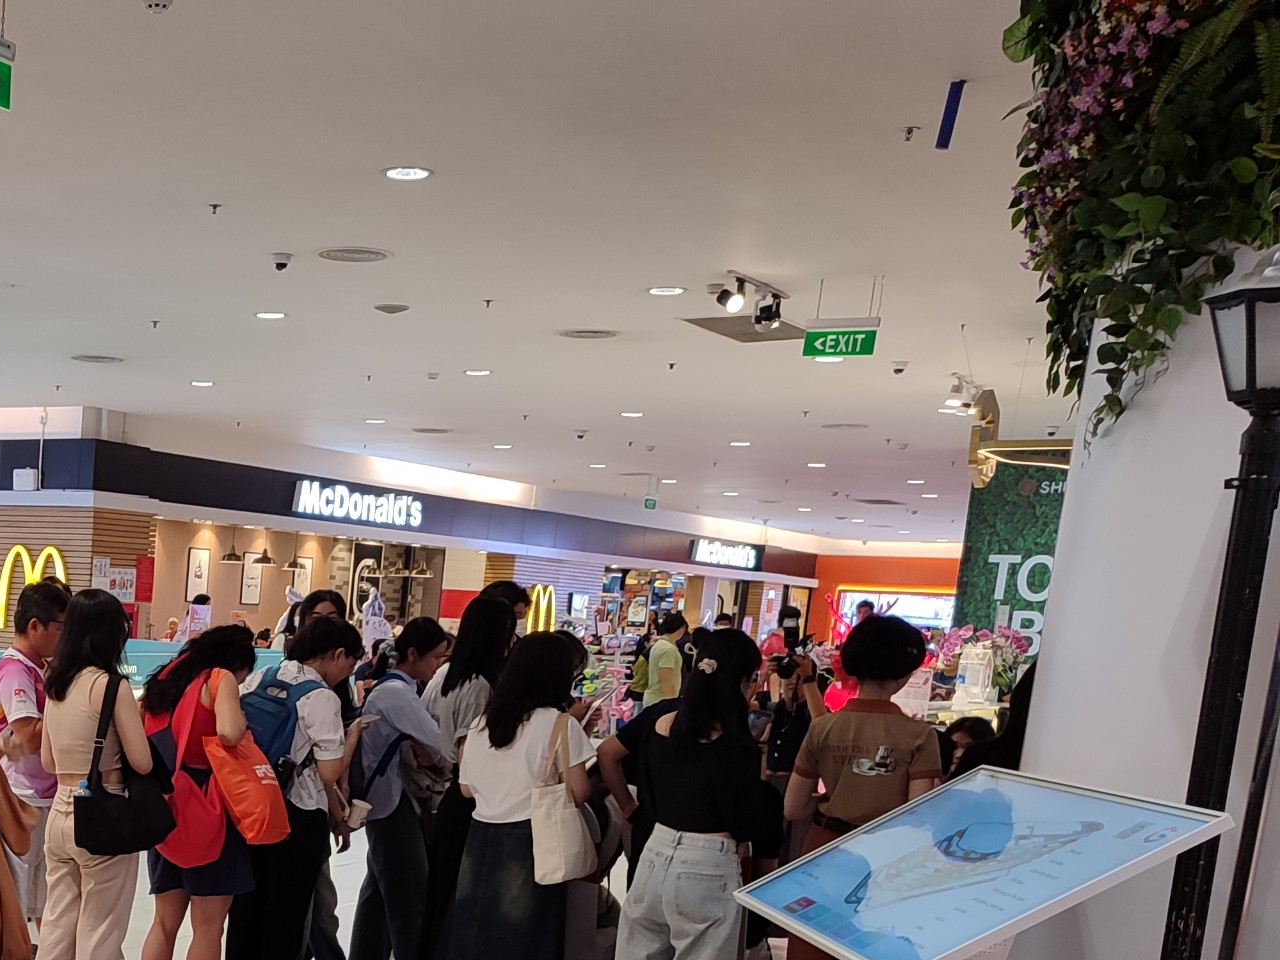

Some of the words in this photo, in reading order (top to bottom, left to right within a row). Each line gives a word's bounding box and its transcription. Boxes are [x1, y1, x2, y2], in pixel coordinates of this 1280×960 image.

[825, 334, 866, 353] EXIT
[1039, 481, 1068, 494] SH
[293, 480, 422, 527] McDonald's
